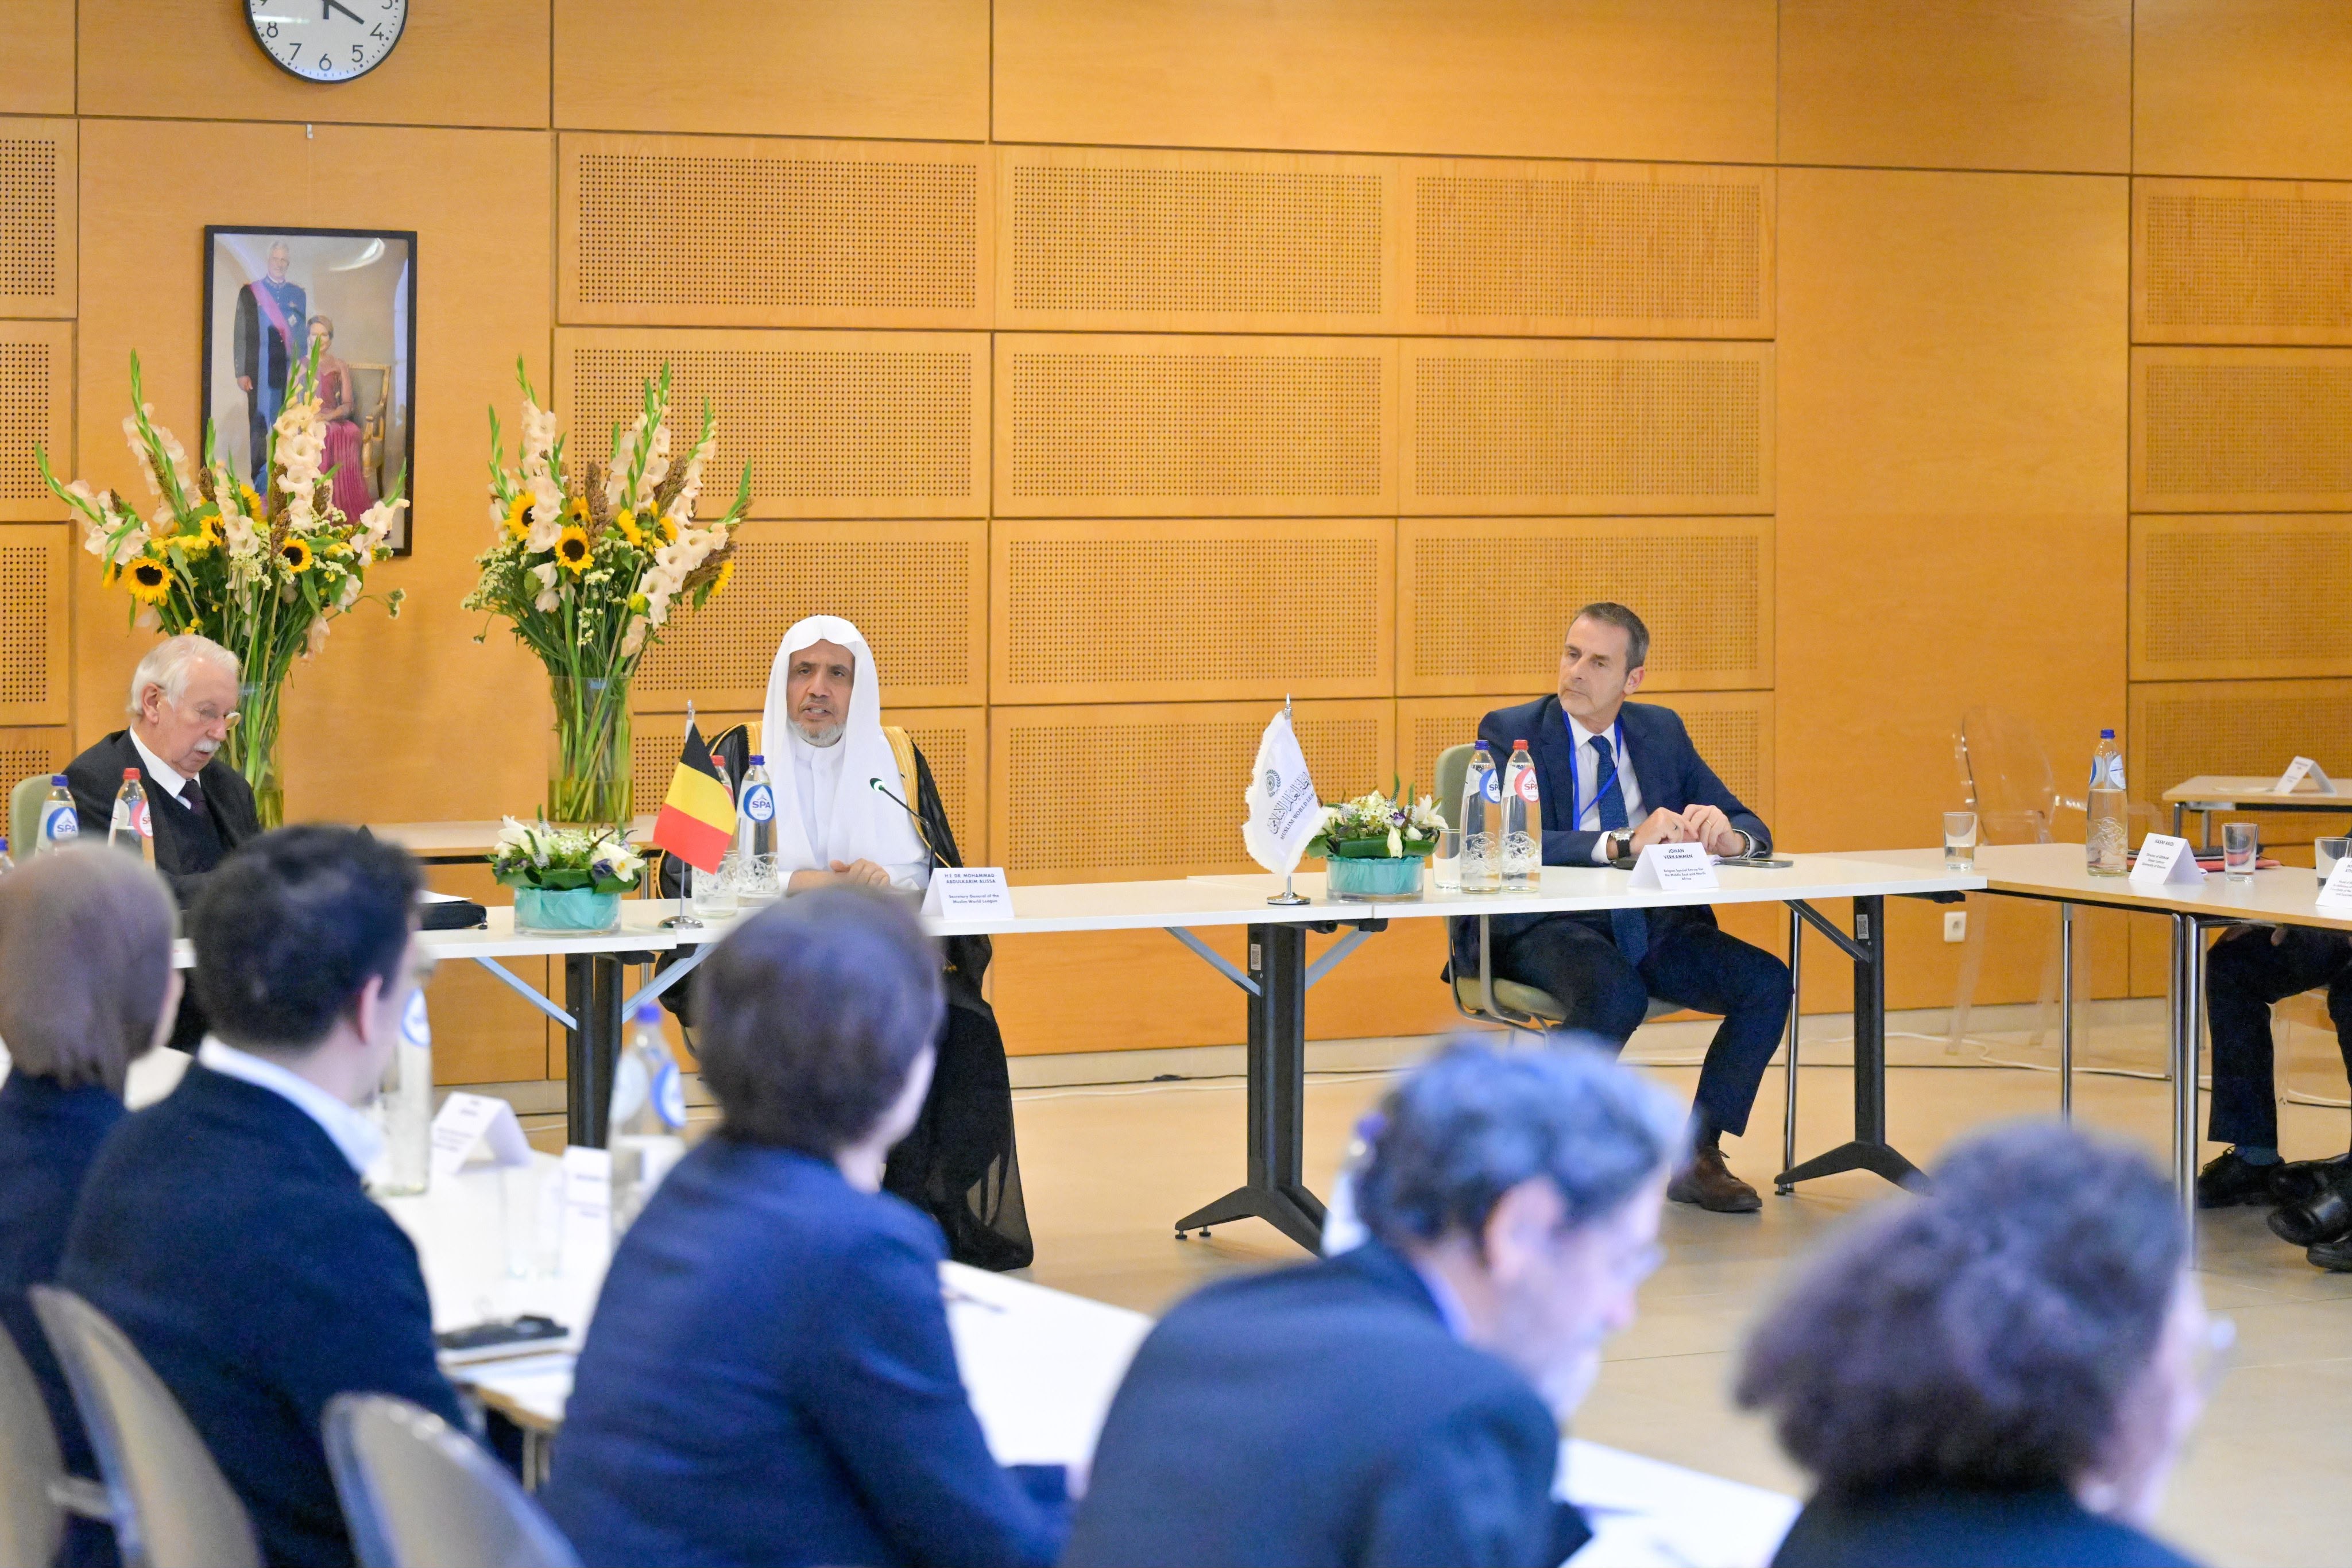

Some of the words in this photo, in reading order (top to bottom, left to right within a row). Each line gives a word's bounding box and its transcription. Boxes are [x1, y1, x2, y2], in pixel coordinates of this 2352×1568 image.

[266, 22, 278, 38] 8
[370, 22, 384, 41] 4
[289, 43, 302, 61] 7
[351, 45, 363, 63] 5
[319, 53, 332, 71] 6
[752, 800, 771, 810] SPA
[57, 824, 76, 833] SPA
[1280, 818, 1295, 840] MUSLIM
[1293, 801, 1308, 819] WORLD
